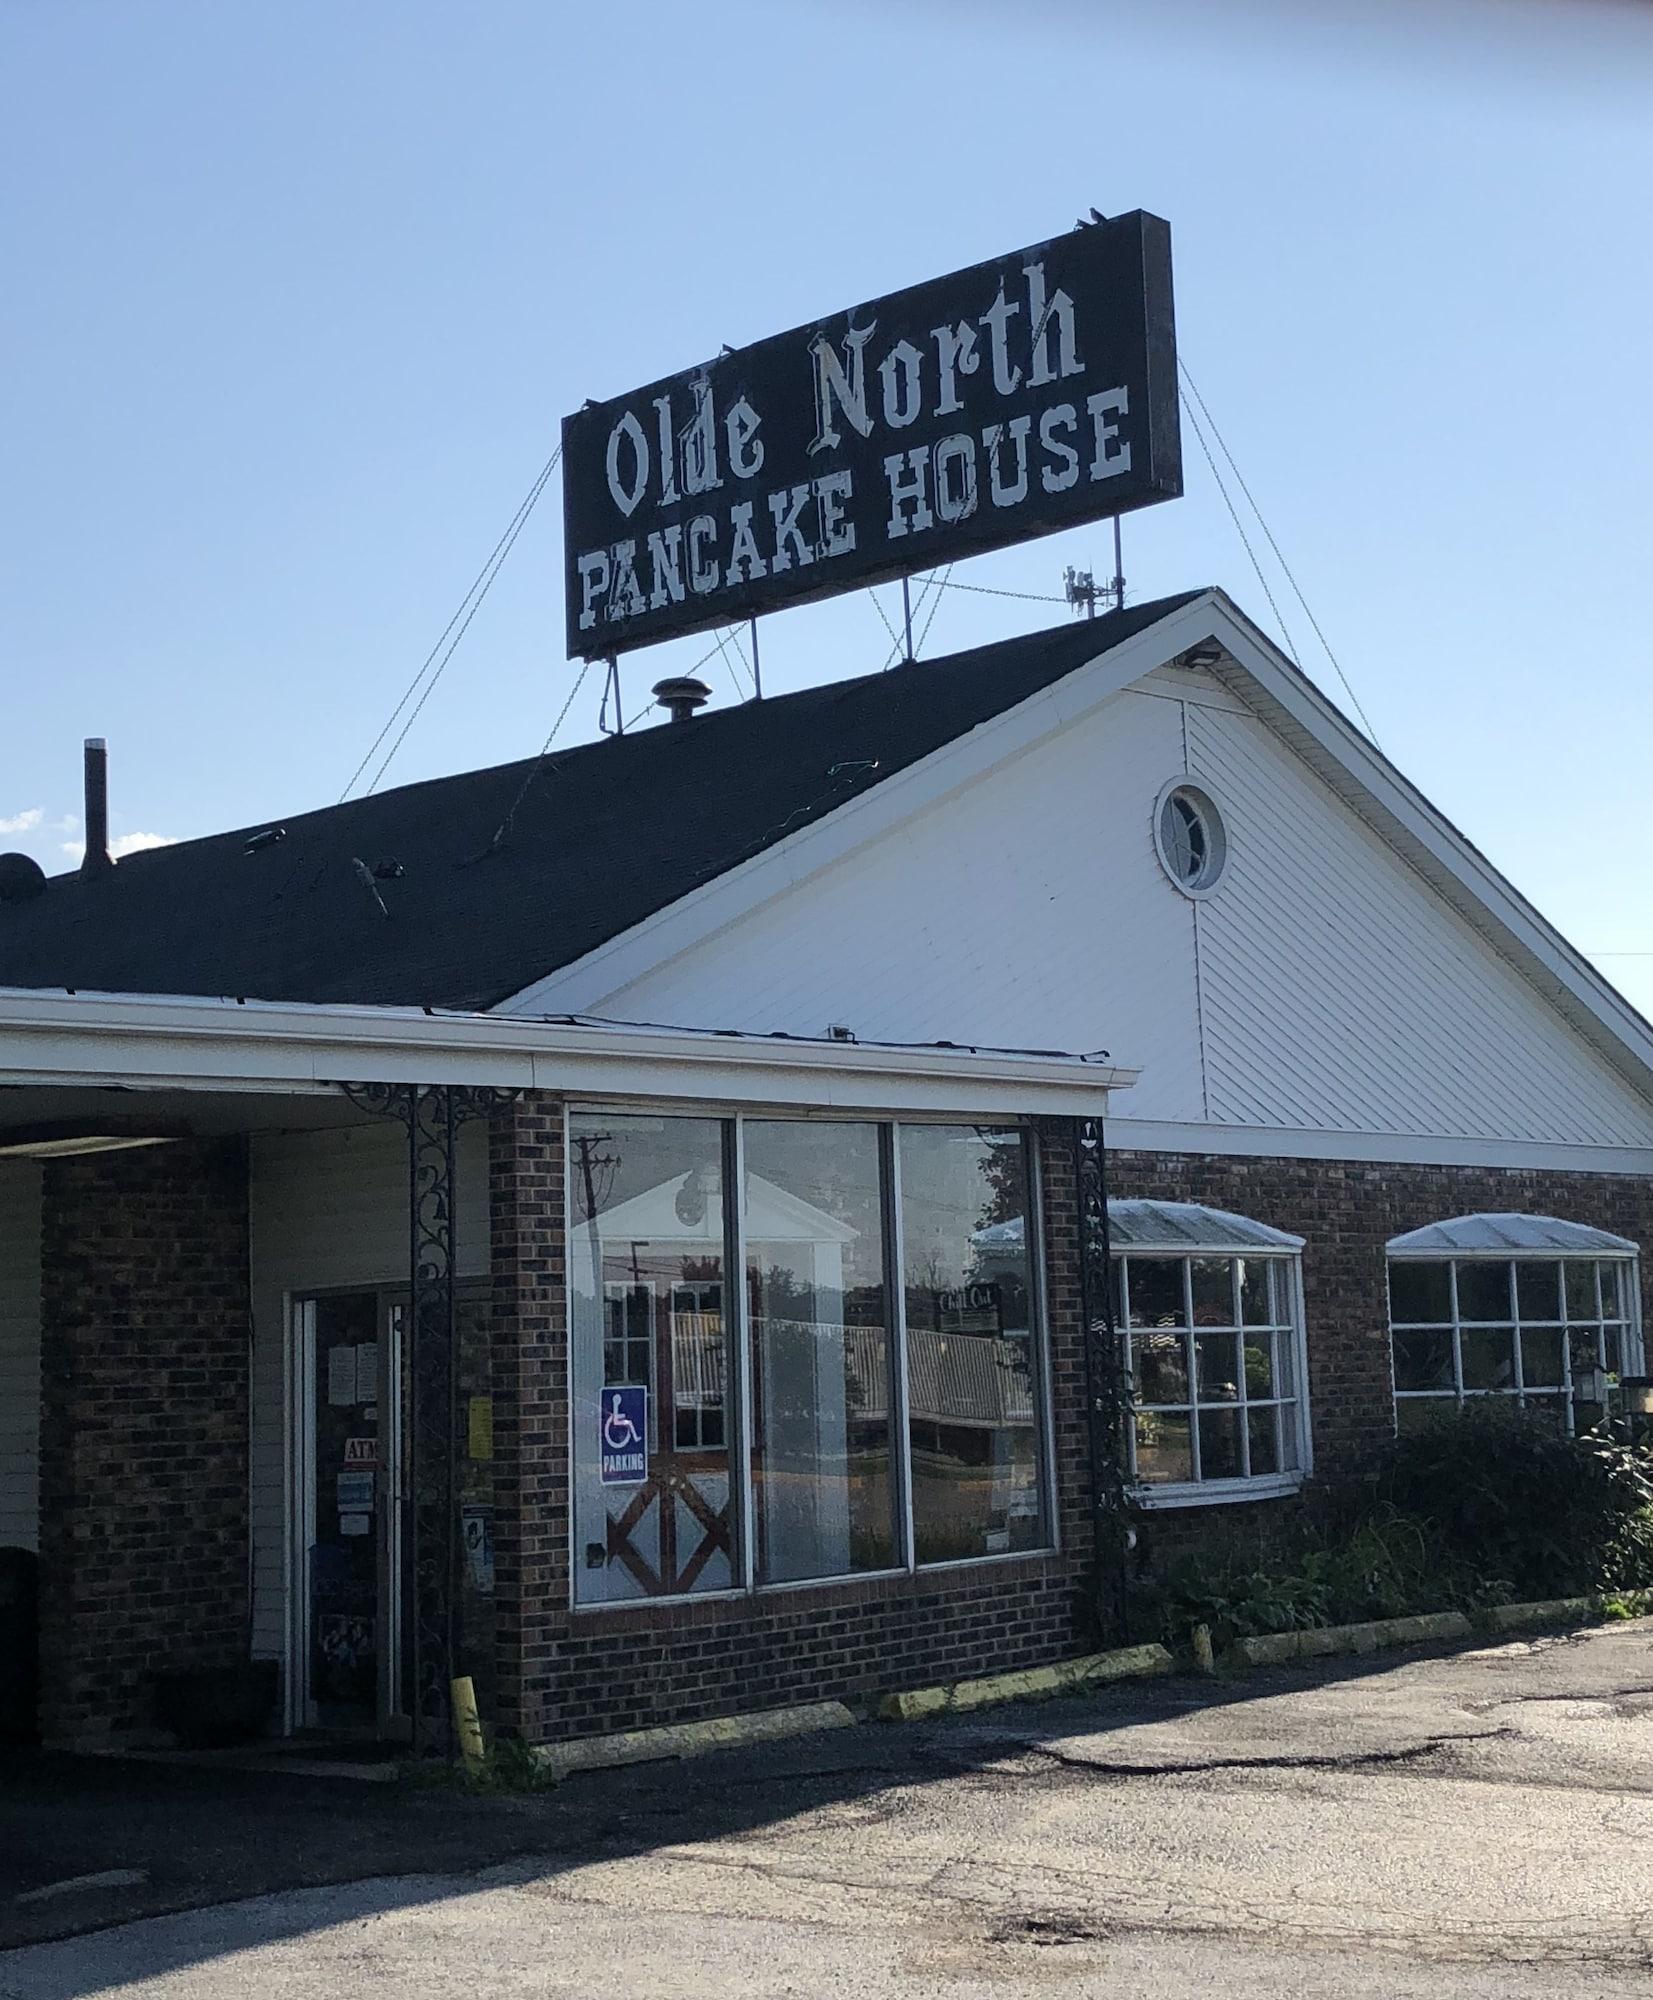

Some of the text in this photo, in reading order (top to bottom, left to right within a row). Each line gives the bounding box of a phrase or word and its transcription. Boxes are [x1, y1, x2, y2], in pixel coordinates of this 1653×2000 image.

[578, 385, 1133, 632] PANCAKE HOUSE
[606, 262, 1086, 517] Olde North
[603, 1453, 644, 1472] PARKING
